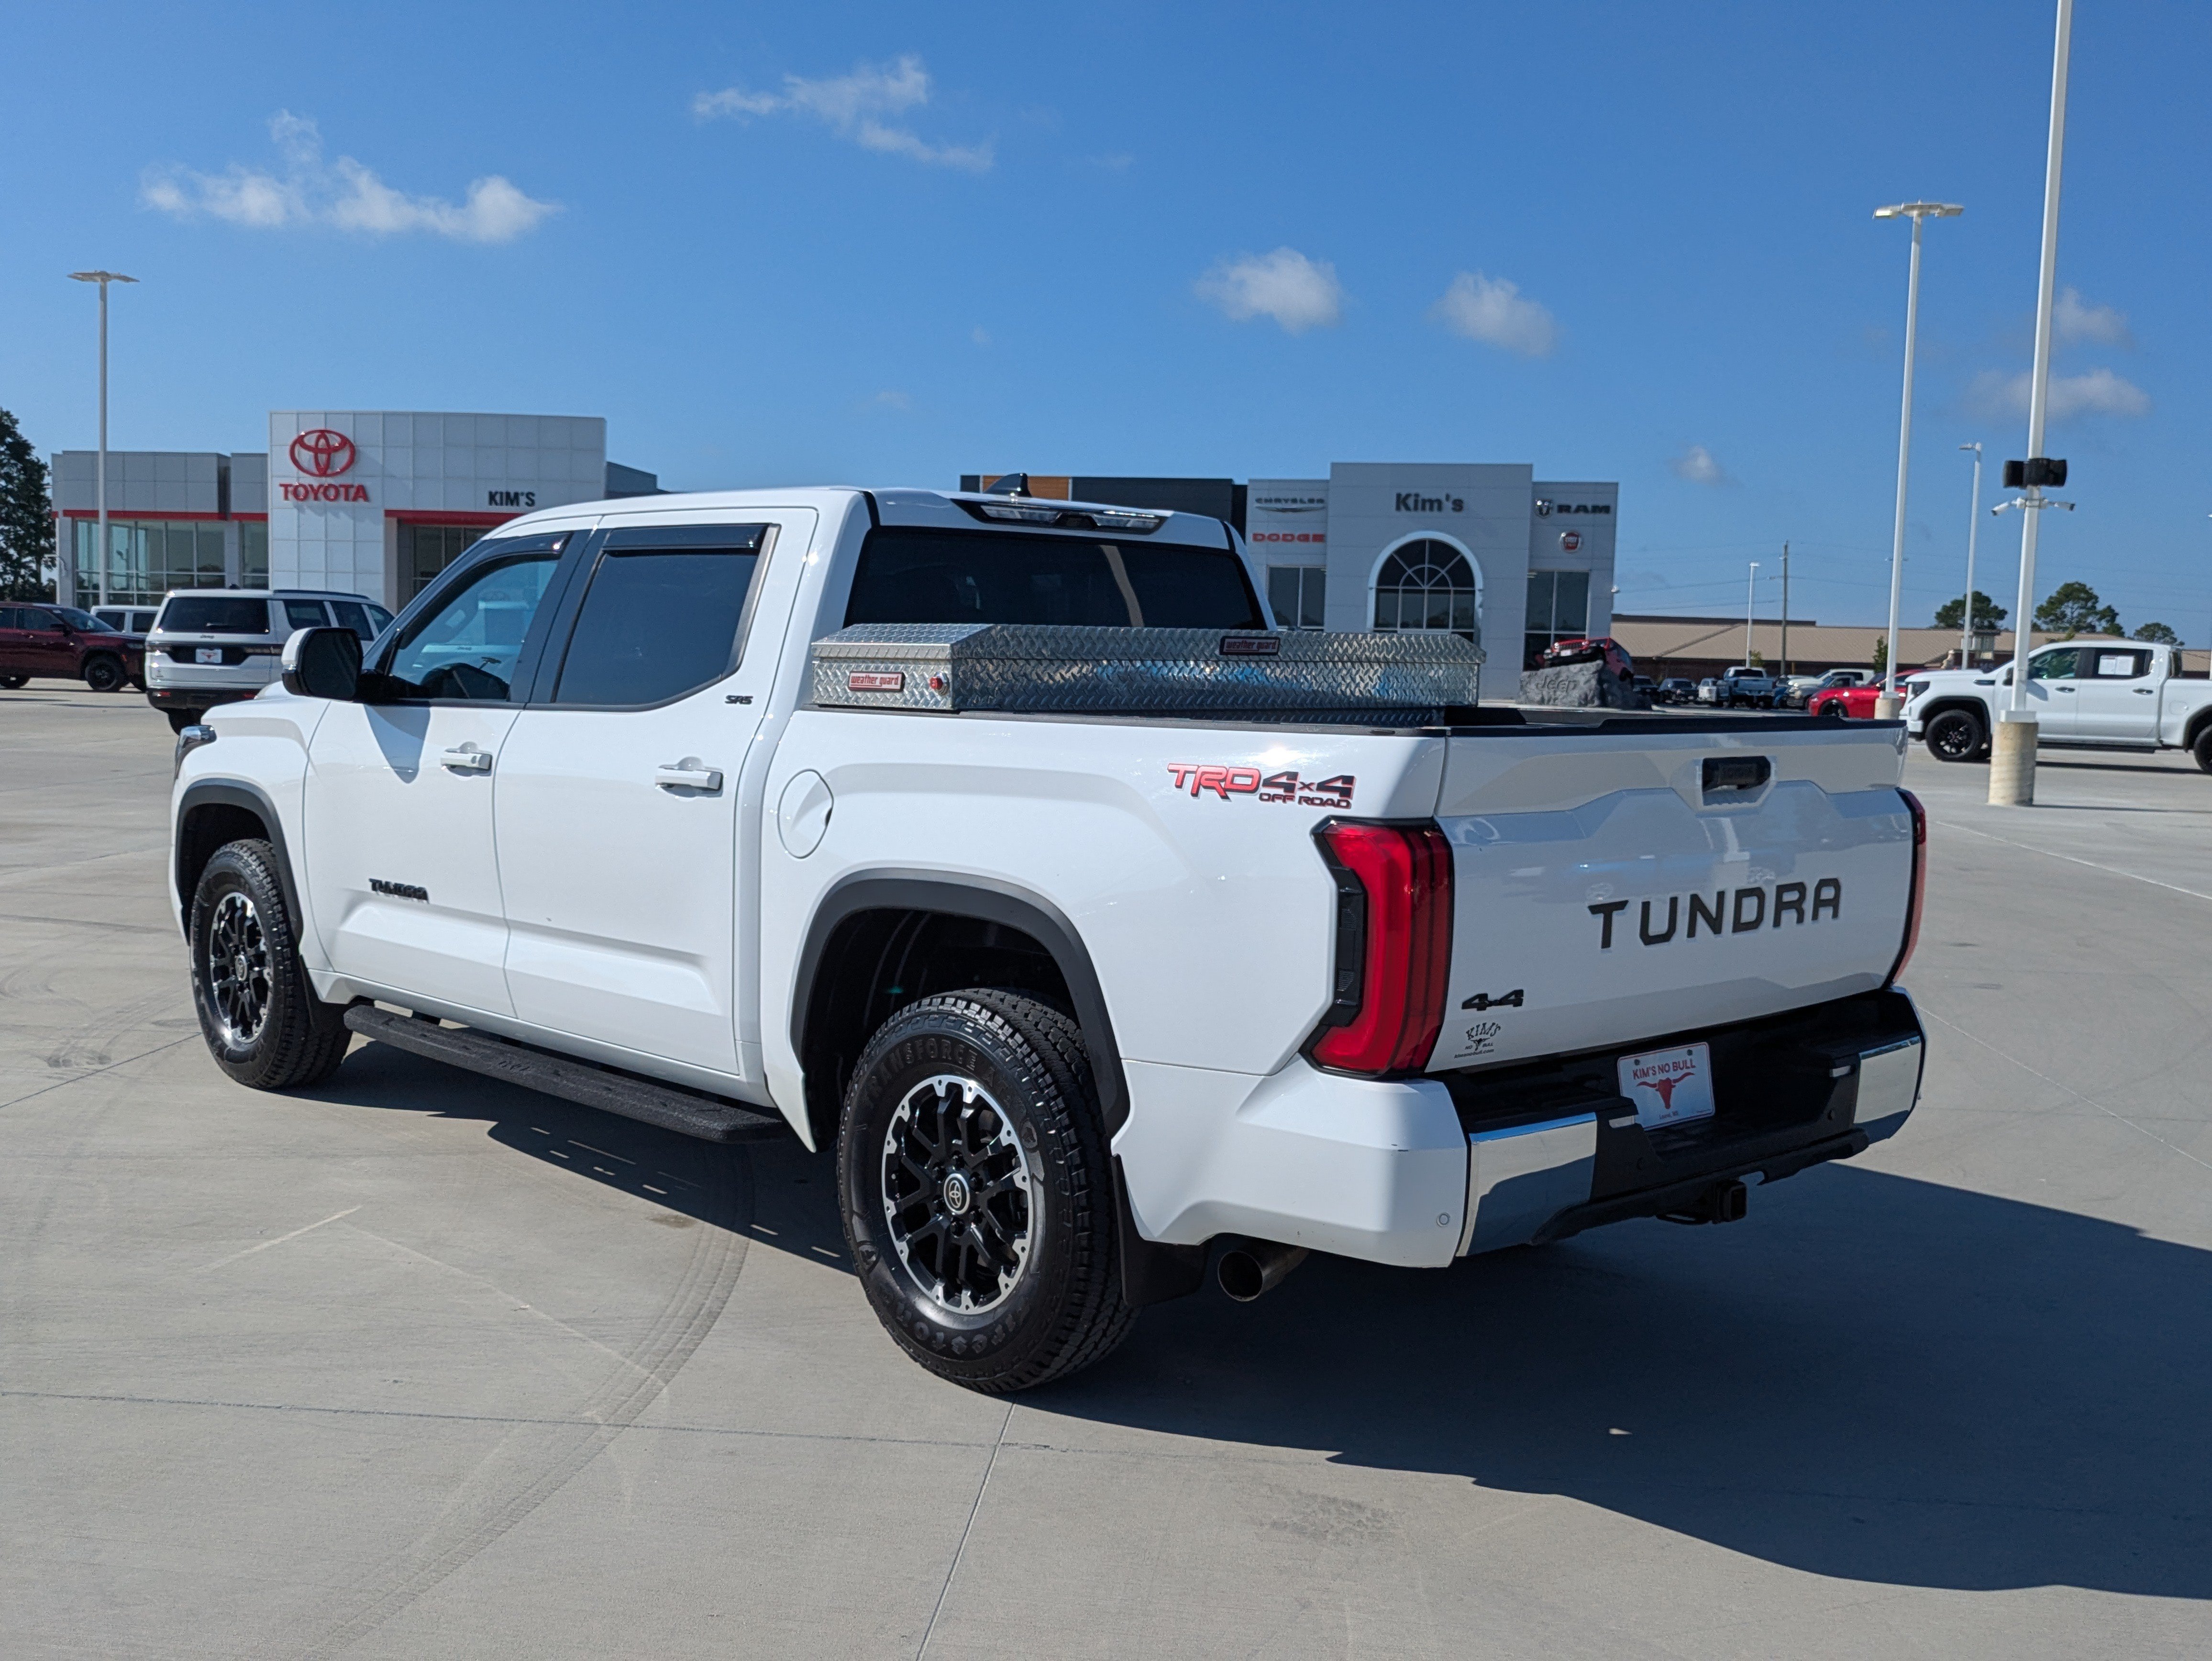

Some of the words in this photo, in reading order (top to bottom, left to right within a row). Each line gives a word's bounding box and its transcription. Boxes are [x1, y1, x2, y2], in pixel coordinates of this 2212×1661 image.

[279, 483, 368, 502] TOYOTA
[489, 491, 535, 507] KIM'S
[1395, 493, 1464, 512] Kim's
[1557, 505, 1611, 514] RAM
[1252, 533, 1325, 543] DODGE
[851, 675, 877, 684] weather
[879, 675, 899, 687] guard
[1536, 675, 1579, 693] Jeep
[725, 695, 753, 705] SR5
[1167, 763, 1262, 802] TRD
[1262, 771, 1357, 799] 4x4
[1259, 792, 1296, 804] OFF
[1298, 796, 1353, 810] ROAD
[368, 878, 429, 901] TUNDRA
[1588, 878, 1841, 949] TUNDRA
[1633, 1066, 1656, 1080] KIM'S
[1658, 1063, 1670, 1074] NO
[1672, 1058, 1696, 1072] BULL
